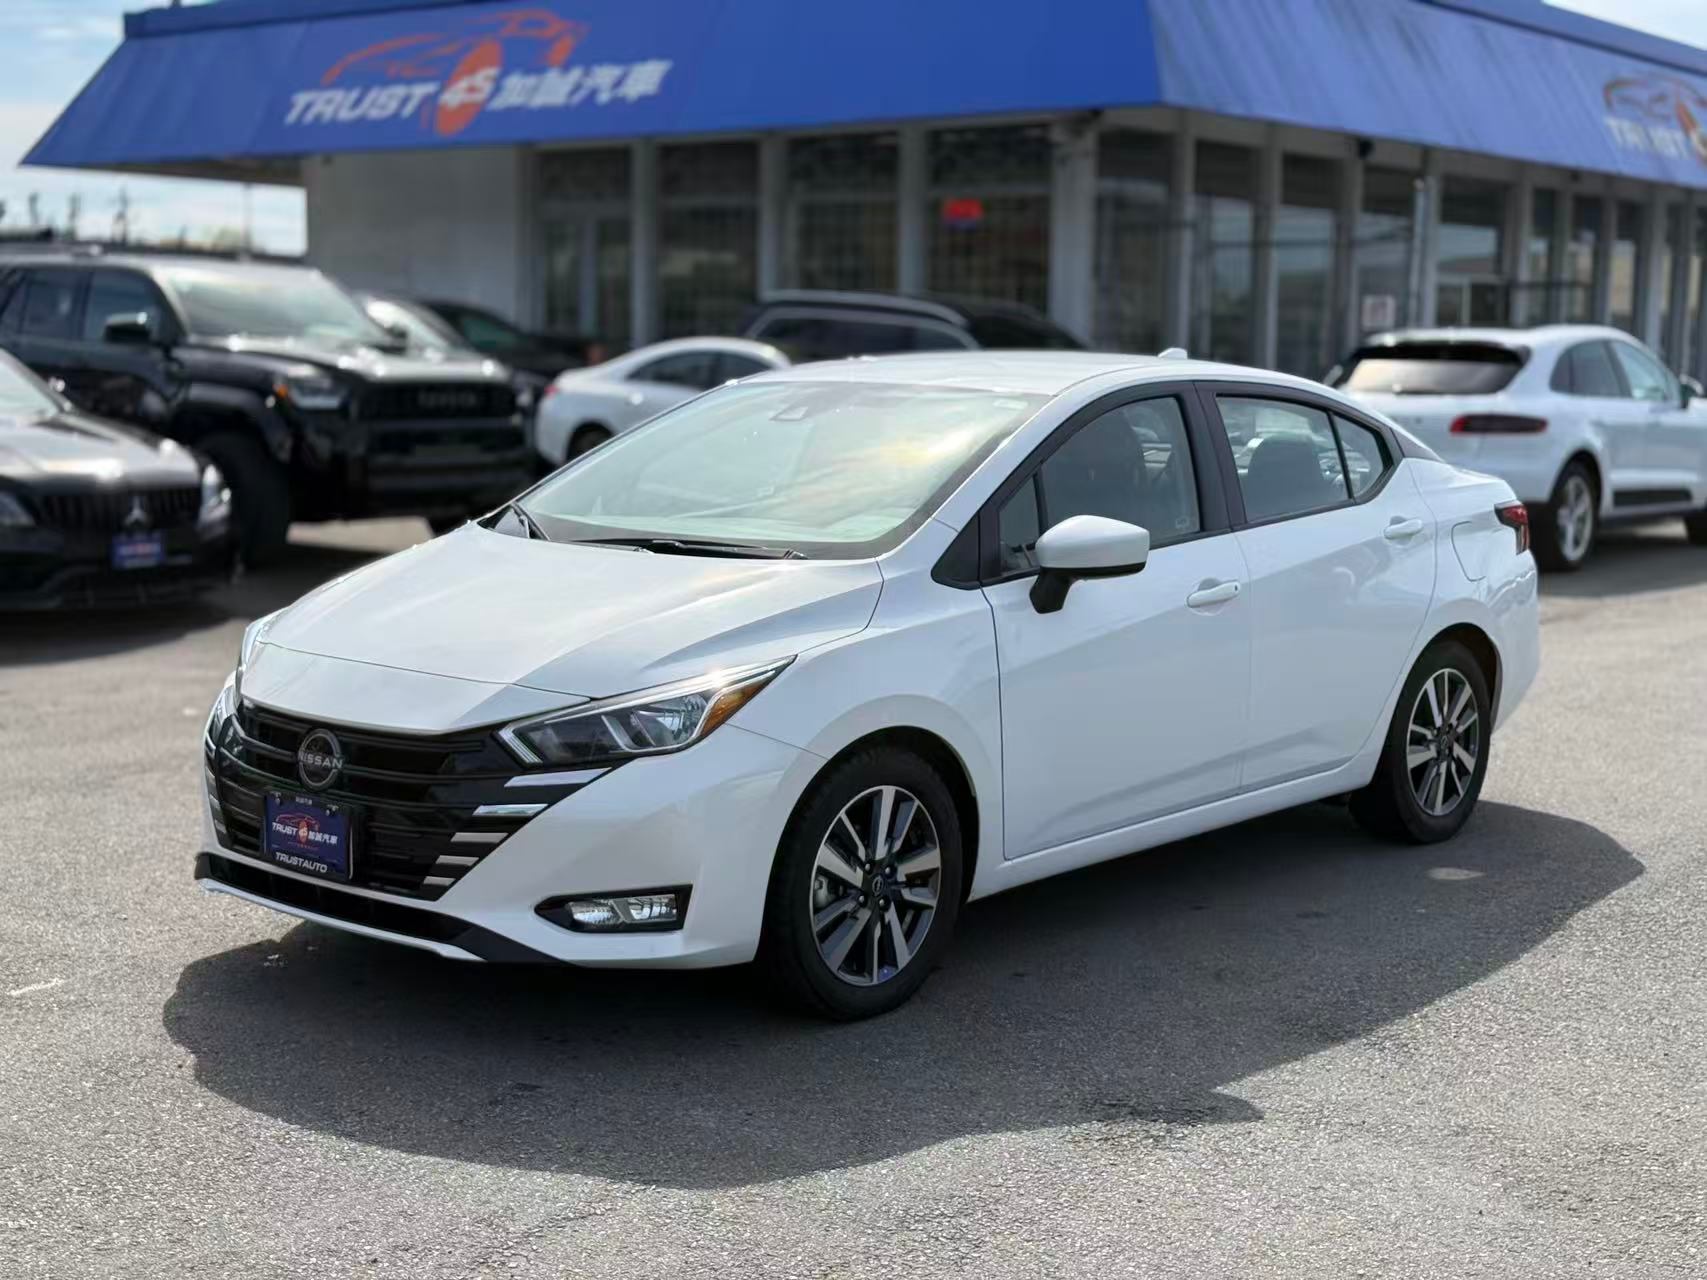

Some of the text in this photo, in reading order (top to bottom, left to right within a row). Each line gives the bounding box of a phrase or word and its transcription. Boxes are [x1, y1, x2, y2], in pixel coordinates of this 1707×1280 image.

[285, 83, 440, 125] TRUST
[299, 751, 343, 769] NISSAN
[272, 822, 298, 835] TRUST
[275, 852, 328, 872] TRUSTAUTO
